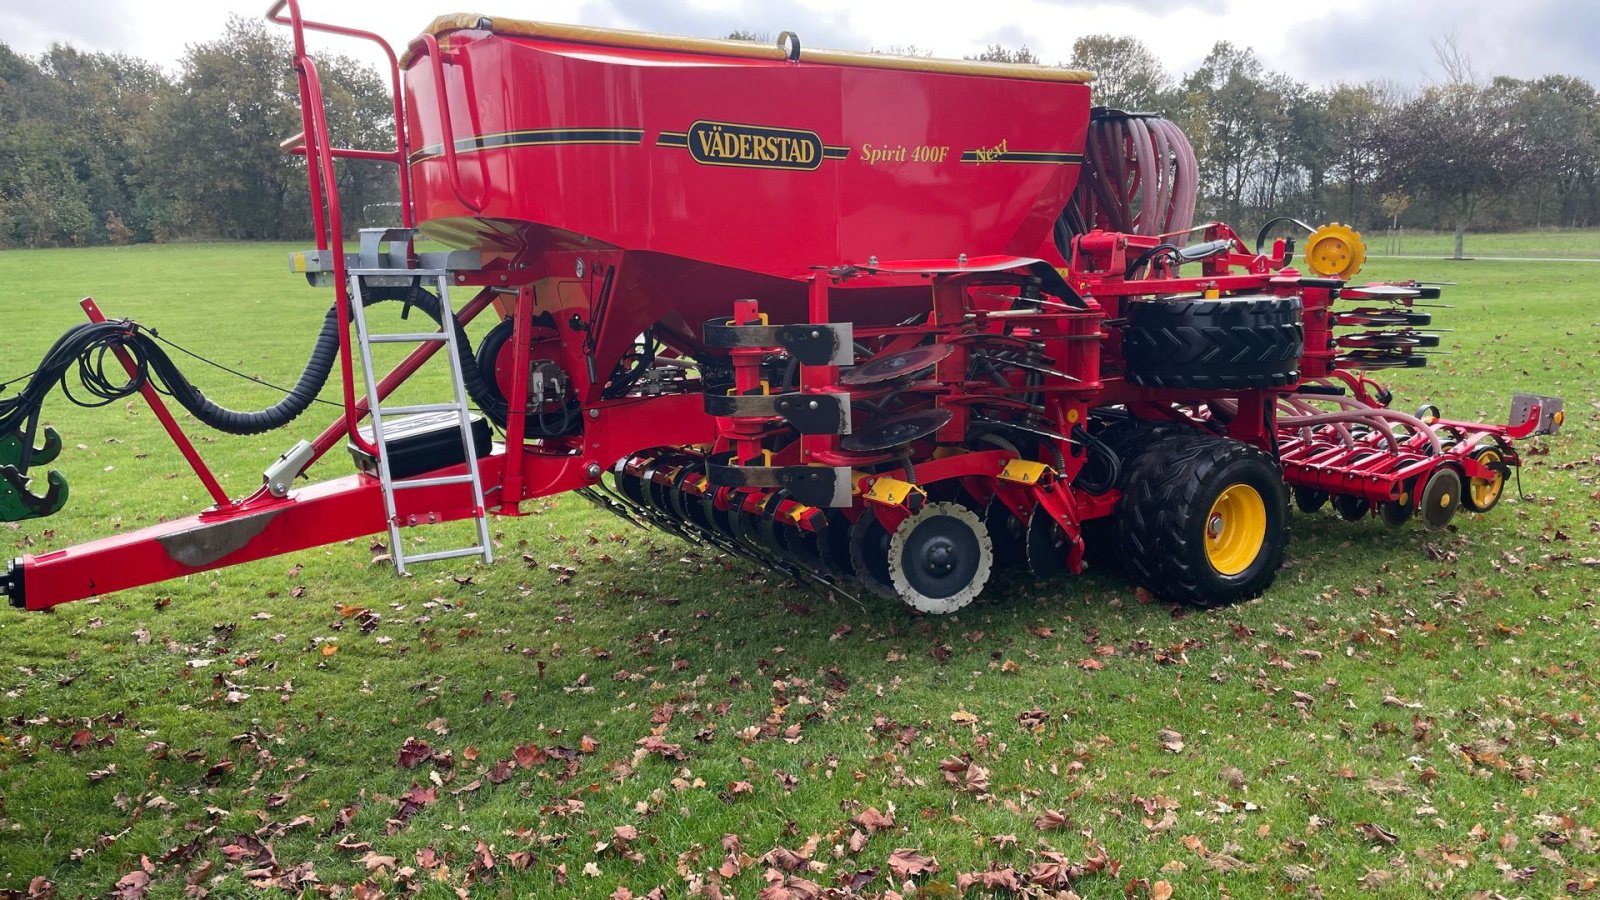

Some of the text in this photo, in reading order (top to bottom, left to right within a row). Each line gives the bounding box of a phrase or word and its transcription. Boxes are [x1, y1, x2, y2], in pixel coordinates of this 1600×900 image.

[698, 125, 814, 163] VÄDERSTAD
[860, 143, 949, 165] Spirit 400F
[974, 138, 1009, 166] Next
